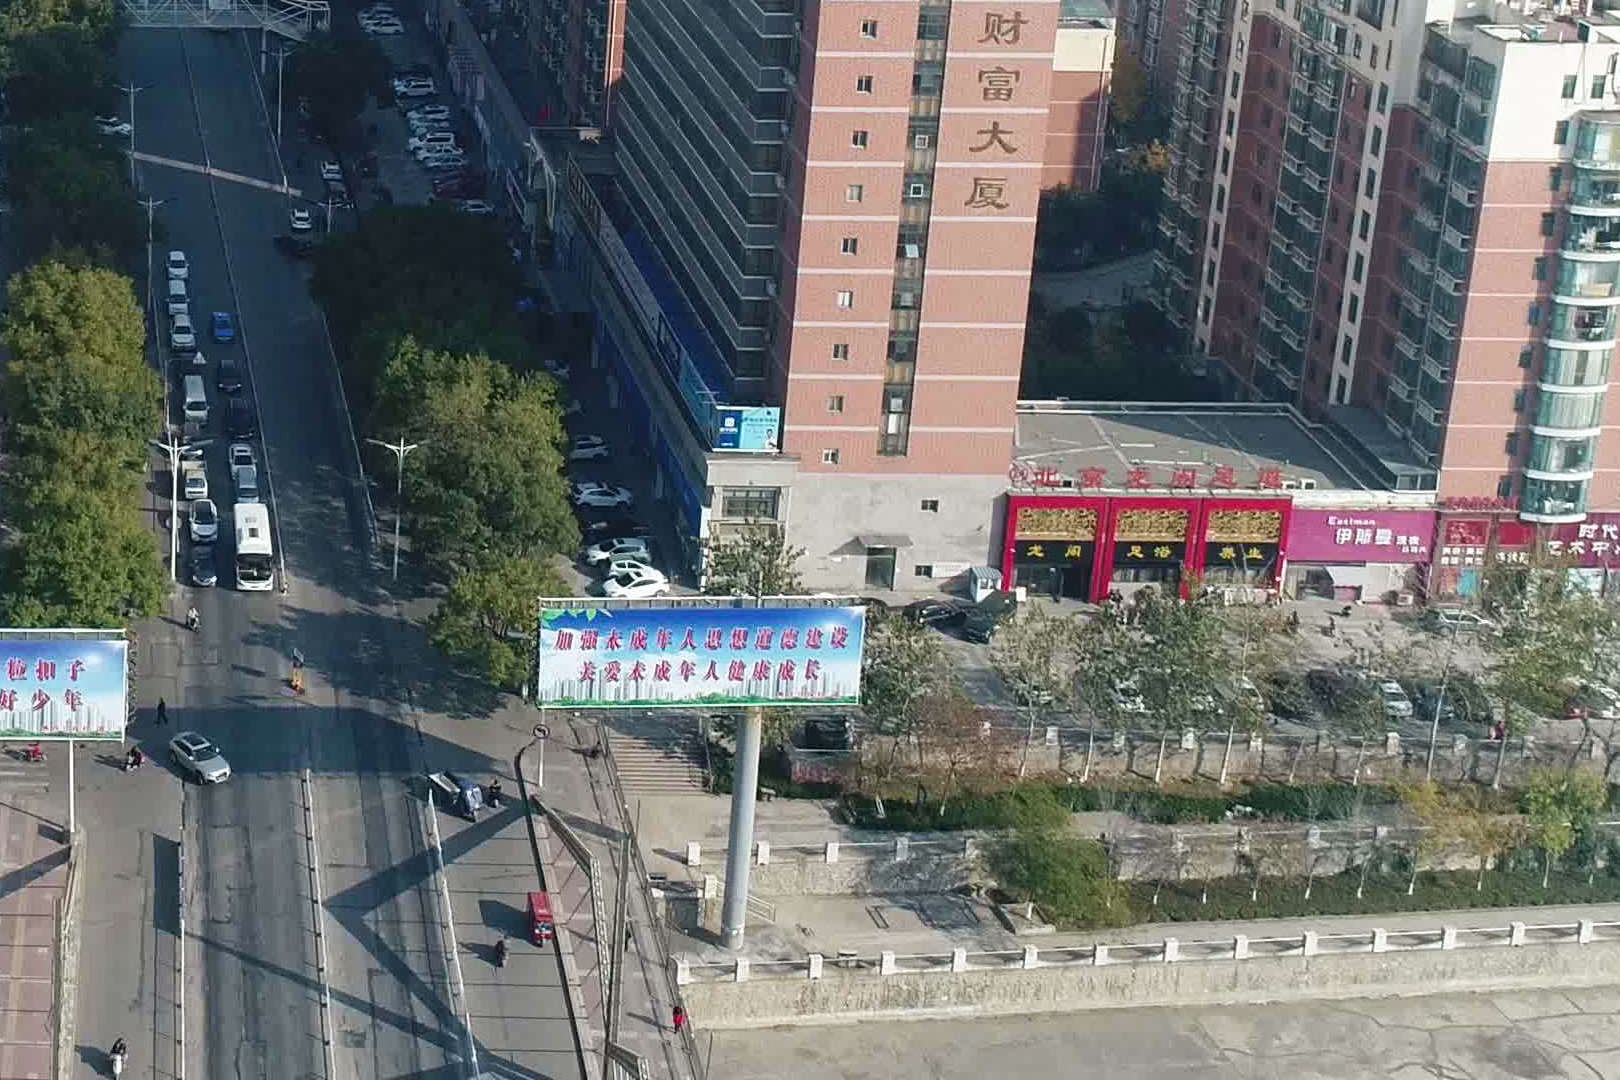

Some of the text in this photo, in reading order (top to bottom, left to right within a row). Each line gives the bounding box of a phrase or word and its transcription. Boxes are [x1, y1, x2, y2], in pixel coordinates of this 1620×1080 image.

[554, 625, 849, 651] 加强未成年人思想道德建设
[580, 659, 823, 682] 关爱未成年人健康成长
